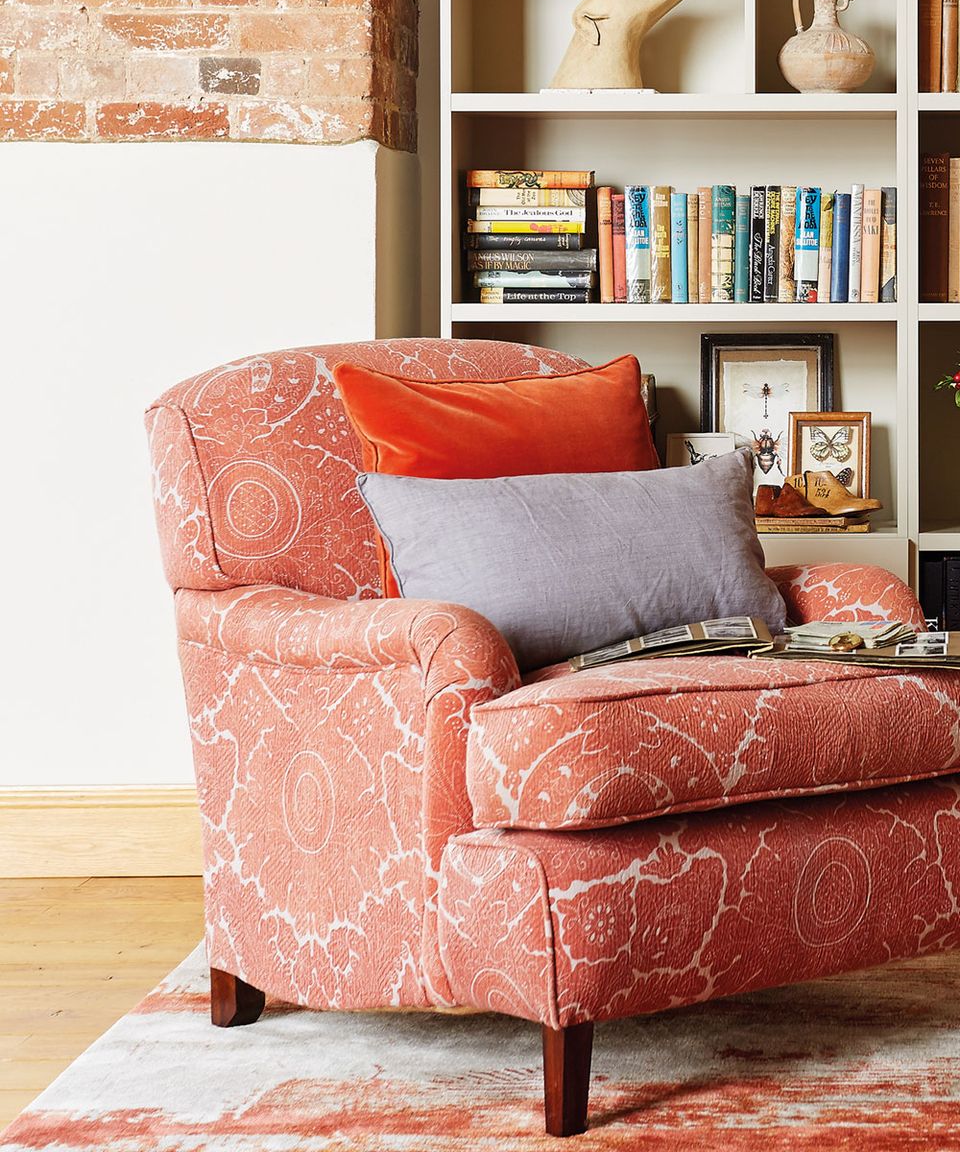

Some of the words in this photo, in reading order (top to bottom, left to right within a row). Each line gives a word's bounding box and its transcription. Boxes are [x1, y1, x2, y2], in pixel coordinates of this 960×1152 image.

[754, 233, 762, 251] The
[474, 253, 500, 261] ANGUS
[754, 254, 763, 273] Black
[766, 245, 775, 265] Angela
[753, 275, 763, 293] Book
[767, 266, 775, 285] Carter
